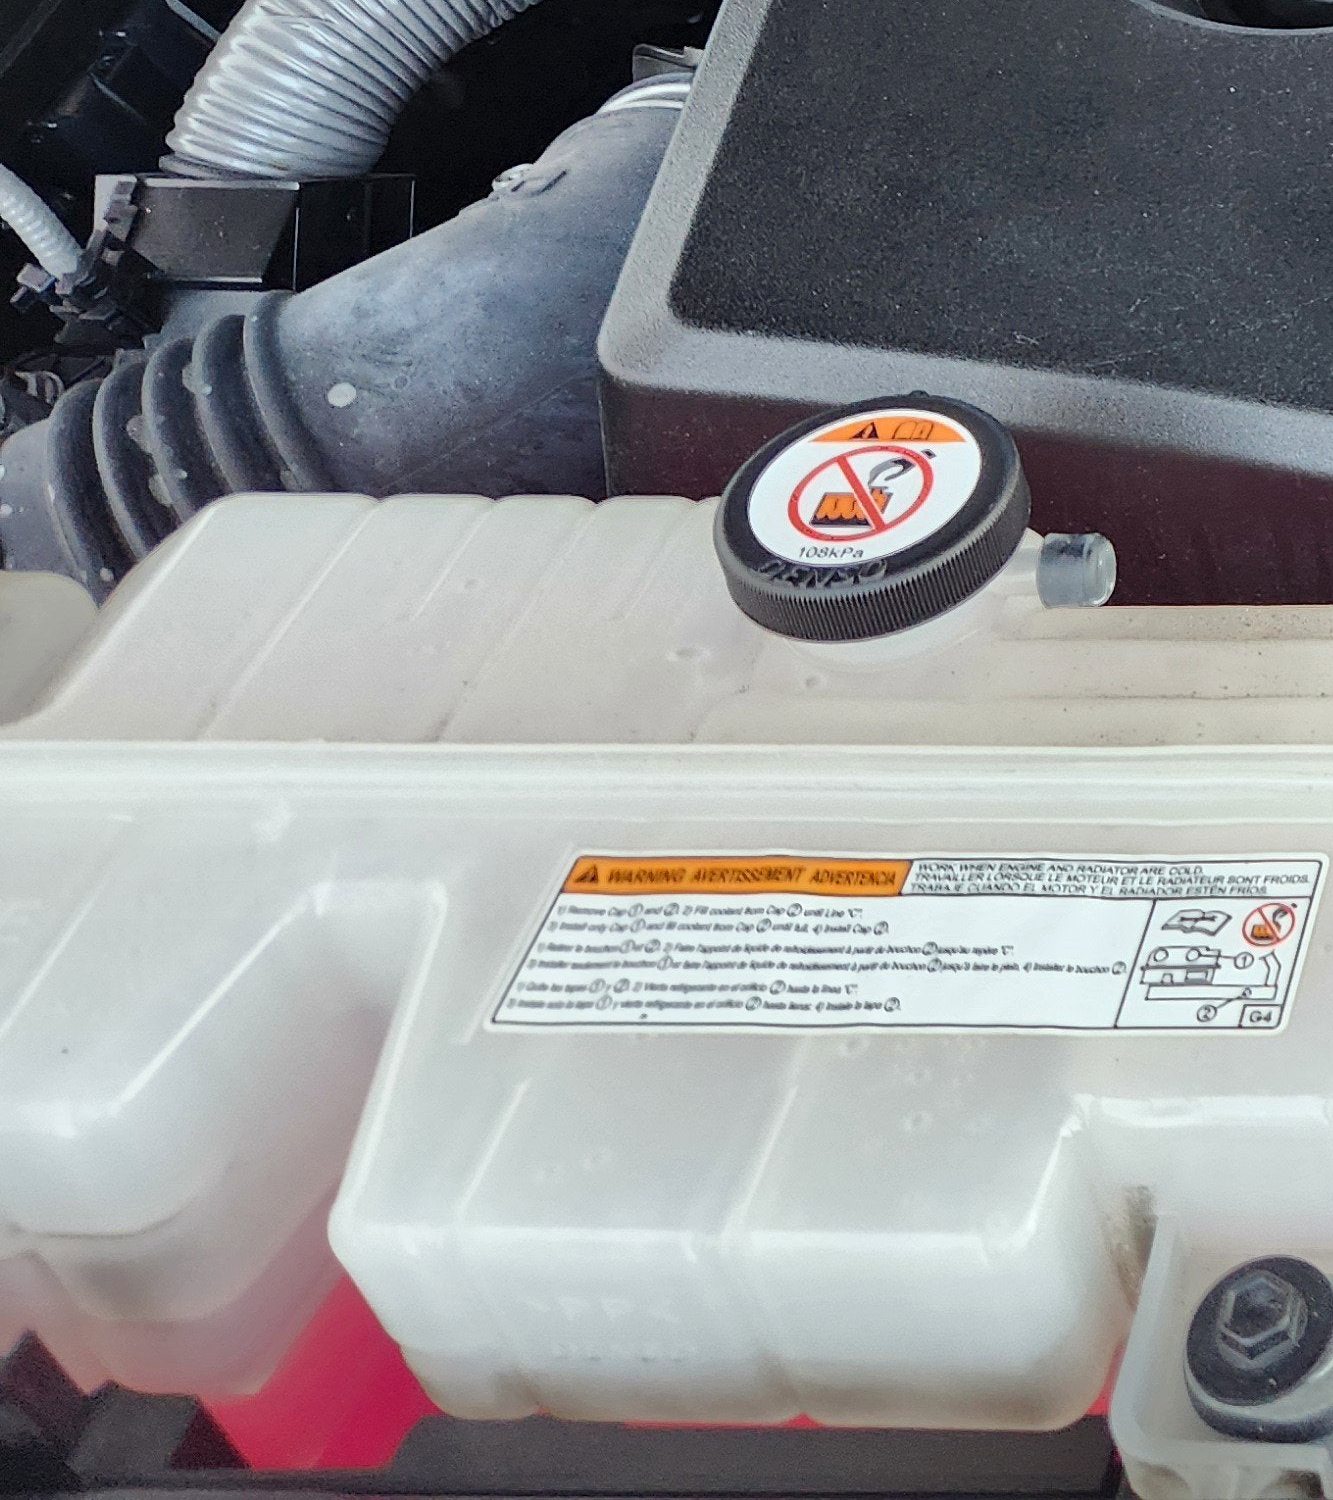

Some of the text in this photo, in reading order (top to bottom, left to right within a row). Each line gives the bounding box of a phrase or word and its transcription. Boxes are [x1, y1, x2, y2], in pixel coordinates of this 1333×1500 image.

[799, 546, 865, 559] 108kPa
[918, 862, 957, 872] WORK
[959, 862, 997, 872] WHEN
[999, 862, 1044, 873] ENGINE
[1047, 863, 1073, 873] AND
[1076, 864, 1139, 875] RADIATOR
[1142, 866, 1165, 876] ARE
[607, 866, 898, 886] WARNING AVERTISSEMENT ADVERTENCIA
[986, 872, 1044, 883] LORSQUE
[1047, 873, 1062, 883] LE
[1065, 874, 1119, 886] MOTEUR
[1121, 876, 1138, 886] ET
[1139, 876, 1155, 886] LE
[1156, 875, 1226, 886] RADIATEUR
[1227, 875, 1261, 885] SONT
[1263, 874, 1310, 885] FROIDS.
[1022, 884, 1036, 893] EL
[1041, 884, 1087, 894] MOTOR
[1101, 886, 1115, 896] EL
[1119, 886, 1183, 896] RADIADOR
[1249, 1011, 1272, 1023] G4
